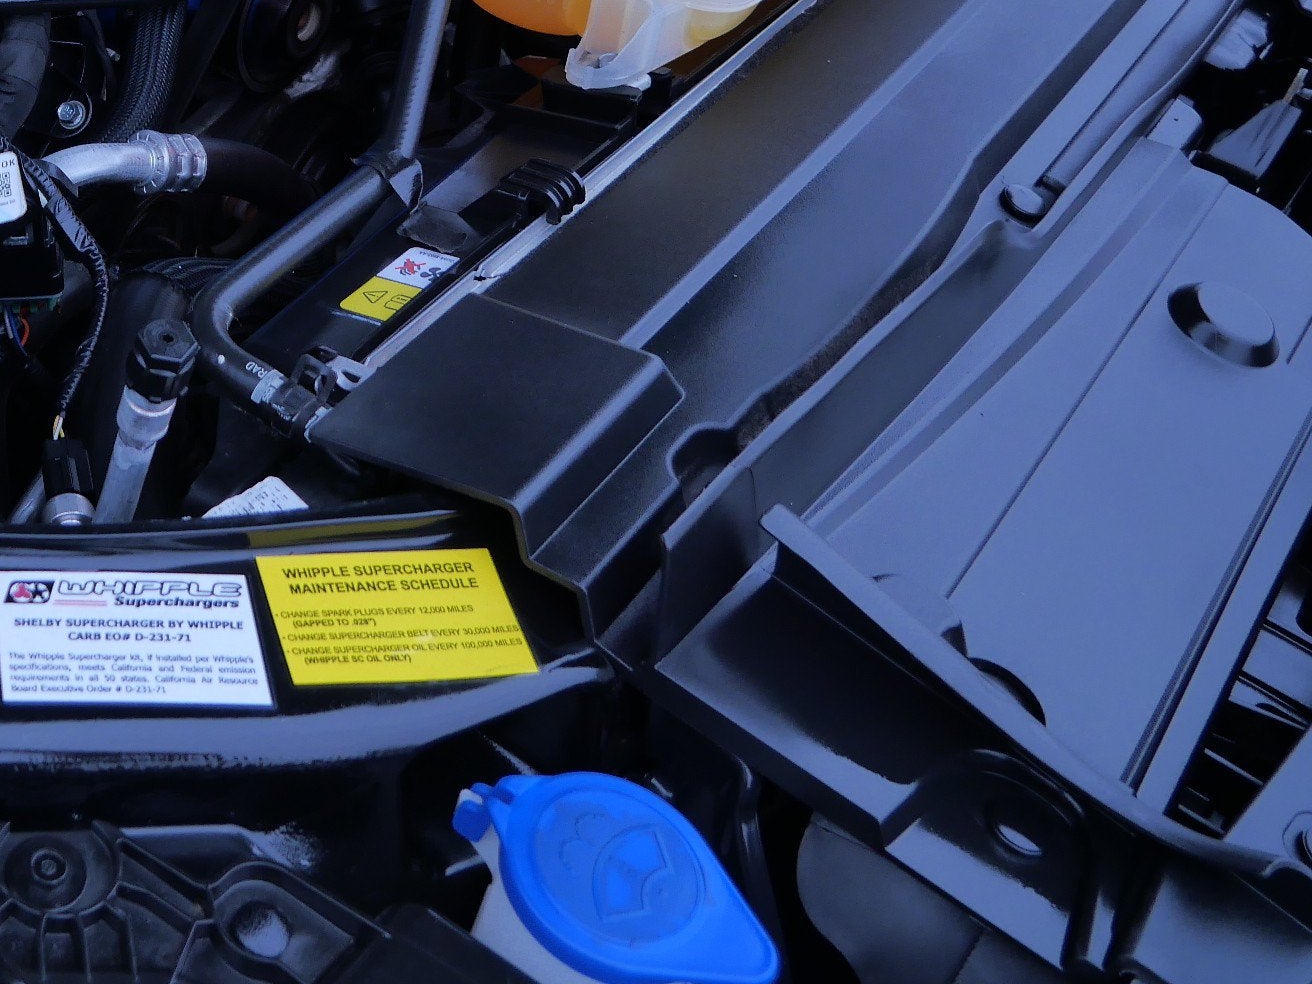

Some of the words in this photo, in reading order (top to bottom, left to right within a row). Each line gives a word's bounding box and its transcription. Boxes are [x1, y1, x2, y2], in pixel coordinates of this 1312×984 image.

[1, 158, 16, 168] OK
[245, 361, 268, 379] RAD
[282, 565, 351, 579] WHIPPLE
[353, 561, 475, 577] SUPERCHARGER
[57, 579, 243, 598] WHIPPLE
[289, 580, 397, 595] MAINTENANCE
[399, 577, 479, 592] SCHEDULE
[114, 596, 240, 610] Superchargers
[280, 609, 319, 619] CHANGE
[321, 608, 352, 617] SPARK
[353, 607, 385, 616] PLUGS
[386, 606, 417, 615] EVERY
[418, 605, 446, 614] 12,000
[446, 604, 474, 613] MILES
[14, 617, 62, 628] SHELBY
[65, 618, 165, 629] SUPERCHARGER
[167, 619, 184, 629] BY
[188, 620, 244, 630] WHIPPLE
[292, 618, 335, 628] (GAPPED
[335, 618, 349, 627] TO
[68, 631, 101, 641] CARB
[105, 632, 131, 641] EO#
[134, 632, 192, 643] D-231-71
[287, 632, 328, 642] CHANGE
[328, 629, 406, 641] SUPERCHARGER
[406, 628, 429, 638] BELT
[430, 627, 461, 637] EVERY
[462, 626, 490, 636] 30,000
[491, 624, 520, 635] MILES
[291, 645, 332, 656] CHANGE
[332, 642, 411, 655] SUPERCHARGER
[411, 642, 428, 651] OIL
[429, 640, 460, 651] EVERY
[460, 639, 495, 649] 100,000
[495, 637, 523, 648] MILES
[28, 652, 65, 663] Whipple
[68, 653, 126, 663] Supercharger
[155, 654, 192, 663] installed
[303, 654, 350, 666] (WHIPPLE
[350, 654, 364, 663] SC
[365, 653, 382, 663] OIL
[383, 652, 413, 663] ONLY)
[78, 664, 106, 672] meets
[111, 663, 153, 673] California
[158, 664, 175, 673] and
[180, 664, 213, 674] Federal
[218, 666, 256, 675] emission
[154, 675, 196, 684] California
[201, 676, 213, 685] Air
[11, 684, 38, 693] Board
[86, 685, 112, 694] Order
